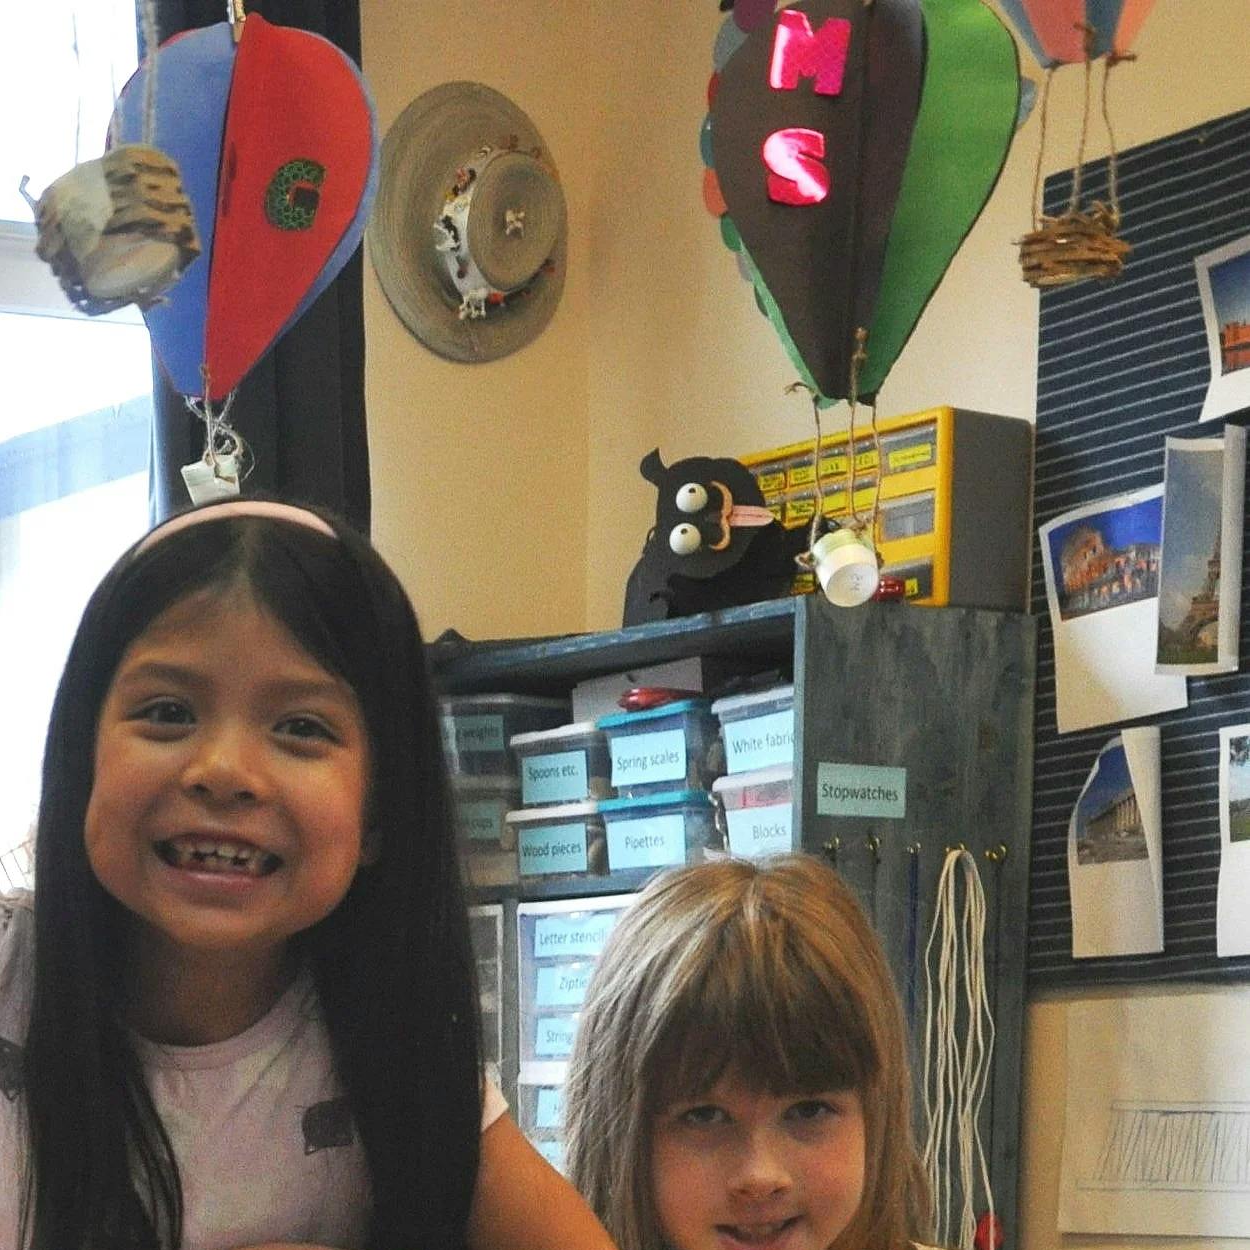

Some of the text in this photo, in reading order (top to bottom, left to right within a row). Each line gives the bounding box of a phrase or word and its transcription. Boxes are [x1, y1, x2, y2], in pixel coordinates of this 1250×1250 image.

[770, 9, 851, 95] M
[762, 127, 830, 207] S
[264, 158, 326, 231] G
[732, 735, 763, 754] White
[617, 750, 680, 772] Spring scales
[528, 764, 579, 783] Spoons etc.
[821, 783, 898, 802] Stopwatches
[752, 823, 787, 840] Blocks
[521, 841, 581, 858] Wood pieces
[624, 833, 665, 850] Pipettes
[539, 932, 568, 946] Letter
